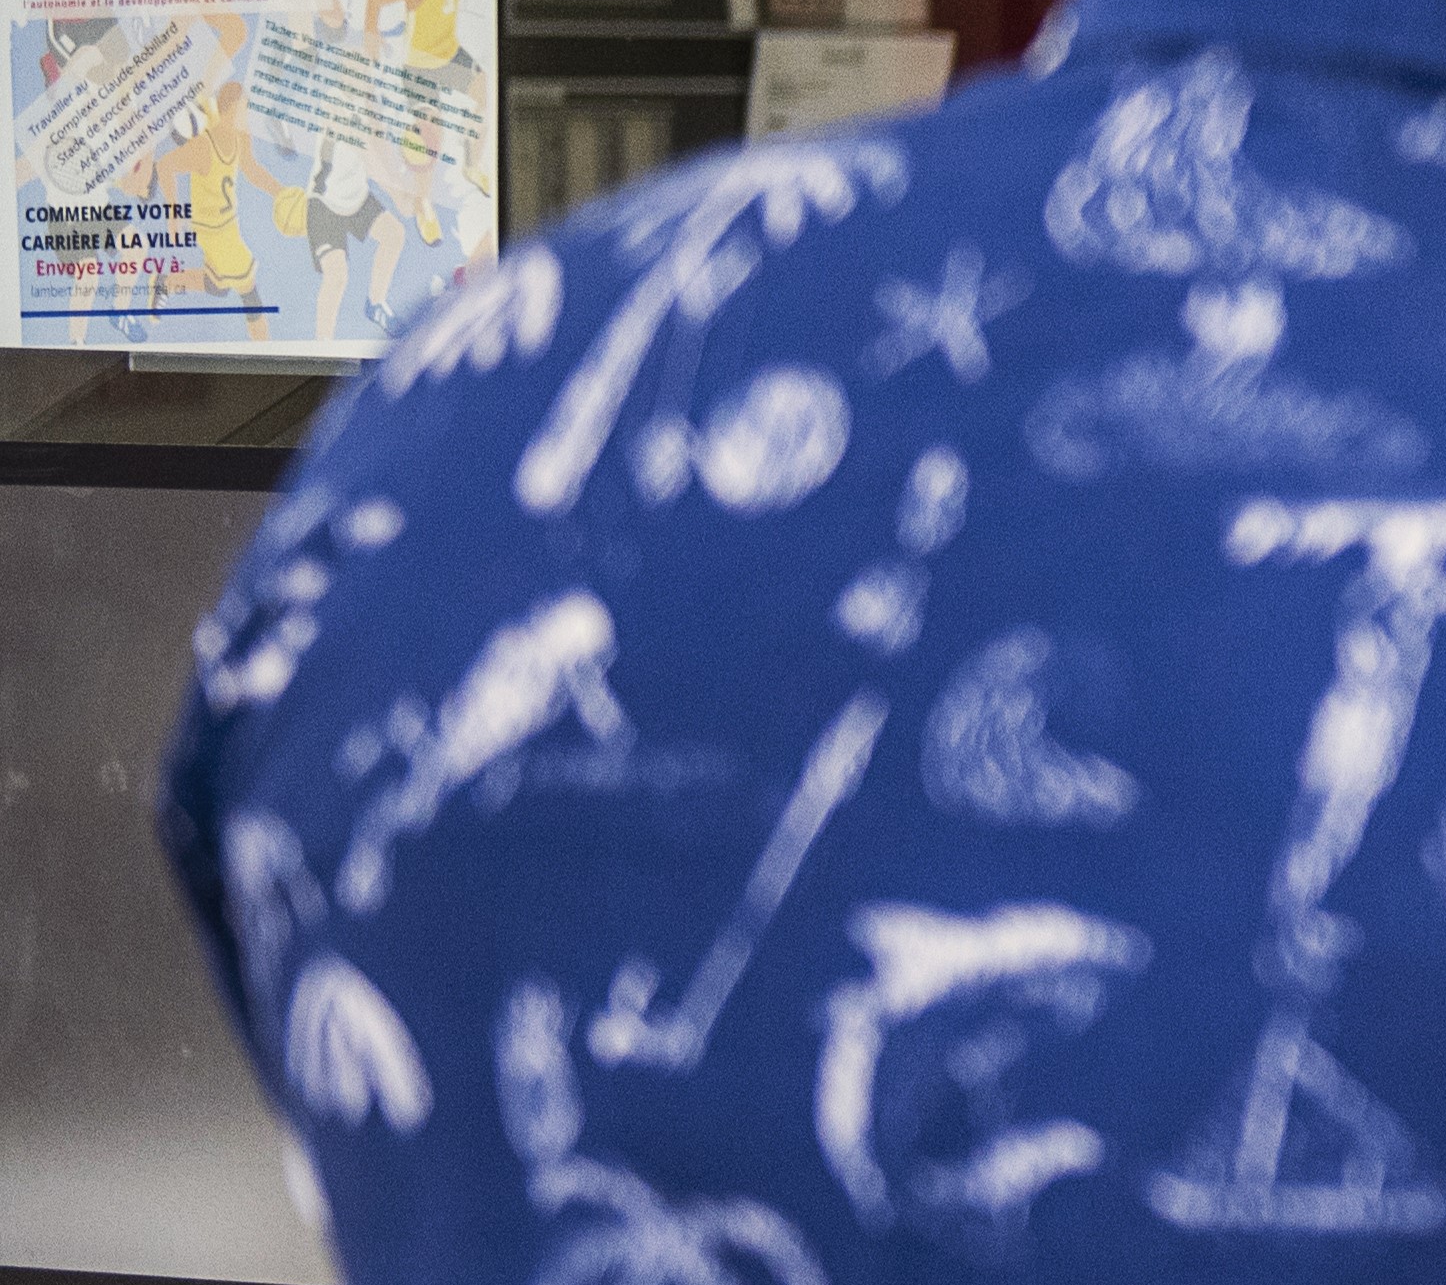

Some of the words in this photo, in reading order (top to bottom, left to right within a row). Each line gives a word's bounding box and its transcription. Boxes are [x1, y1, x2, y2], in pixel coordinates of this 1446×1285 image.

[28, 91, 75, 137] Travailler
[76, 80, 89, 97] au
[50, 97, 98, 145] Complexe
[100, 21, 179, 99] Claude-Robillard
[57, 136, 86, 166] Stade
[87, 123, 100, 138] de
[101, 93, 132, 127] soccer
[133, 81, 147, 96] de
[145, 35, 193, 83] Montréal
[79, 139, 110, 172] Aréna
[109, 66, 190, 143] Maurice-Richard
[114, 133, 149, 165] Michel
[150, 81, 205, 134] Normandin
[21, 230, 100, 252] CARRIÈRE
[104, 227, 117, 250] À
[121, 232, 143, 249] LA
[147, 231, 197, 249] VILLE!
[25, 204, 133, 223] COMMENCEZ
[138, 203, 193, 220] VOTRE
[36, 259, 104, 281] Envoyez
[110, 261, 138, 275] vos
[142, 258, 165, 275] CV
[170, 256, 186, 274] à:
